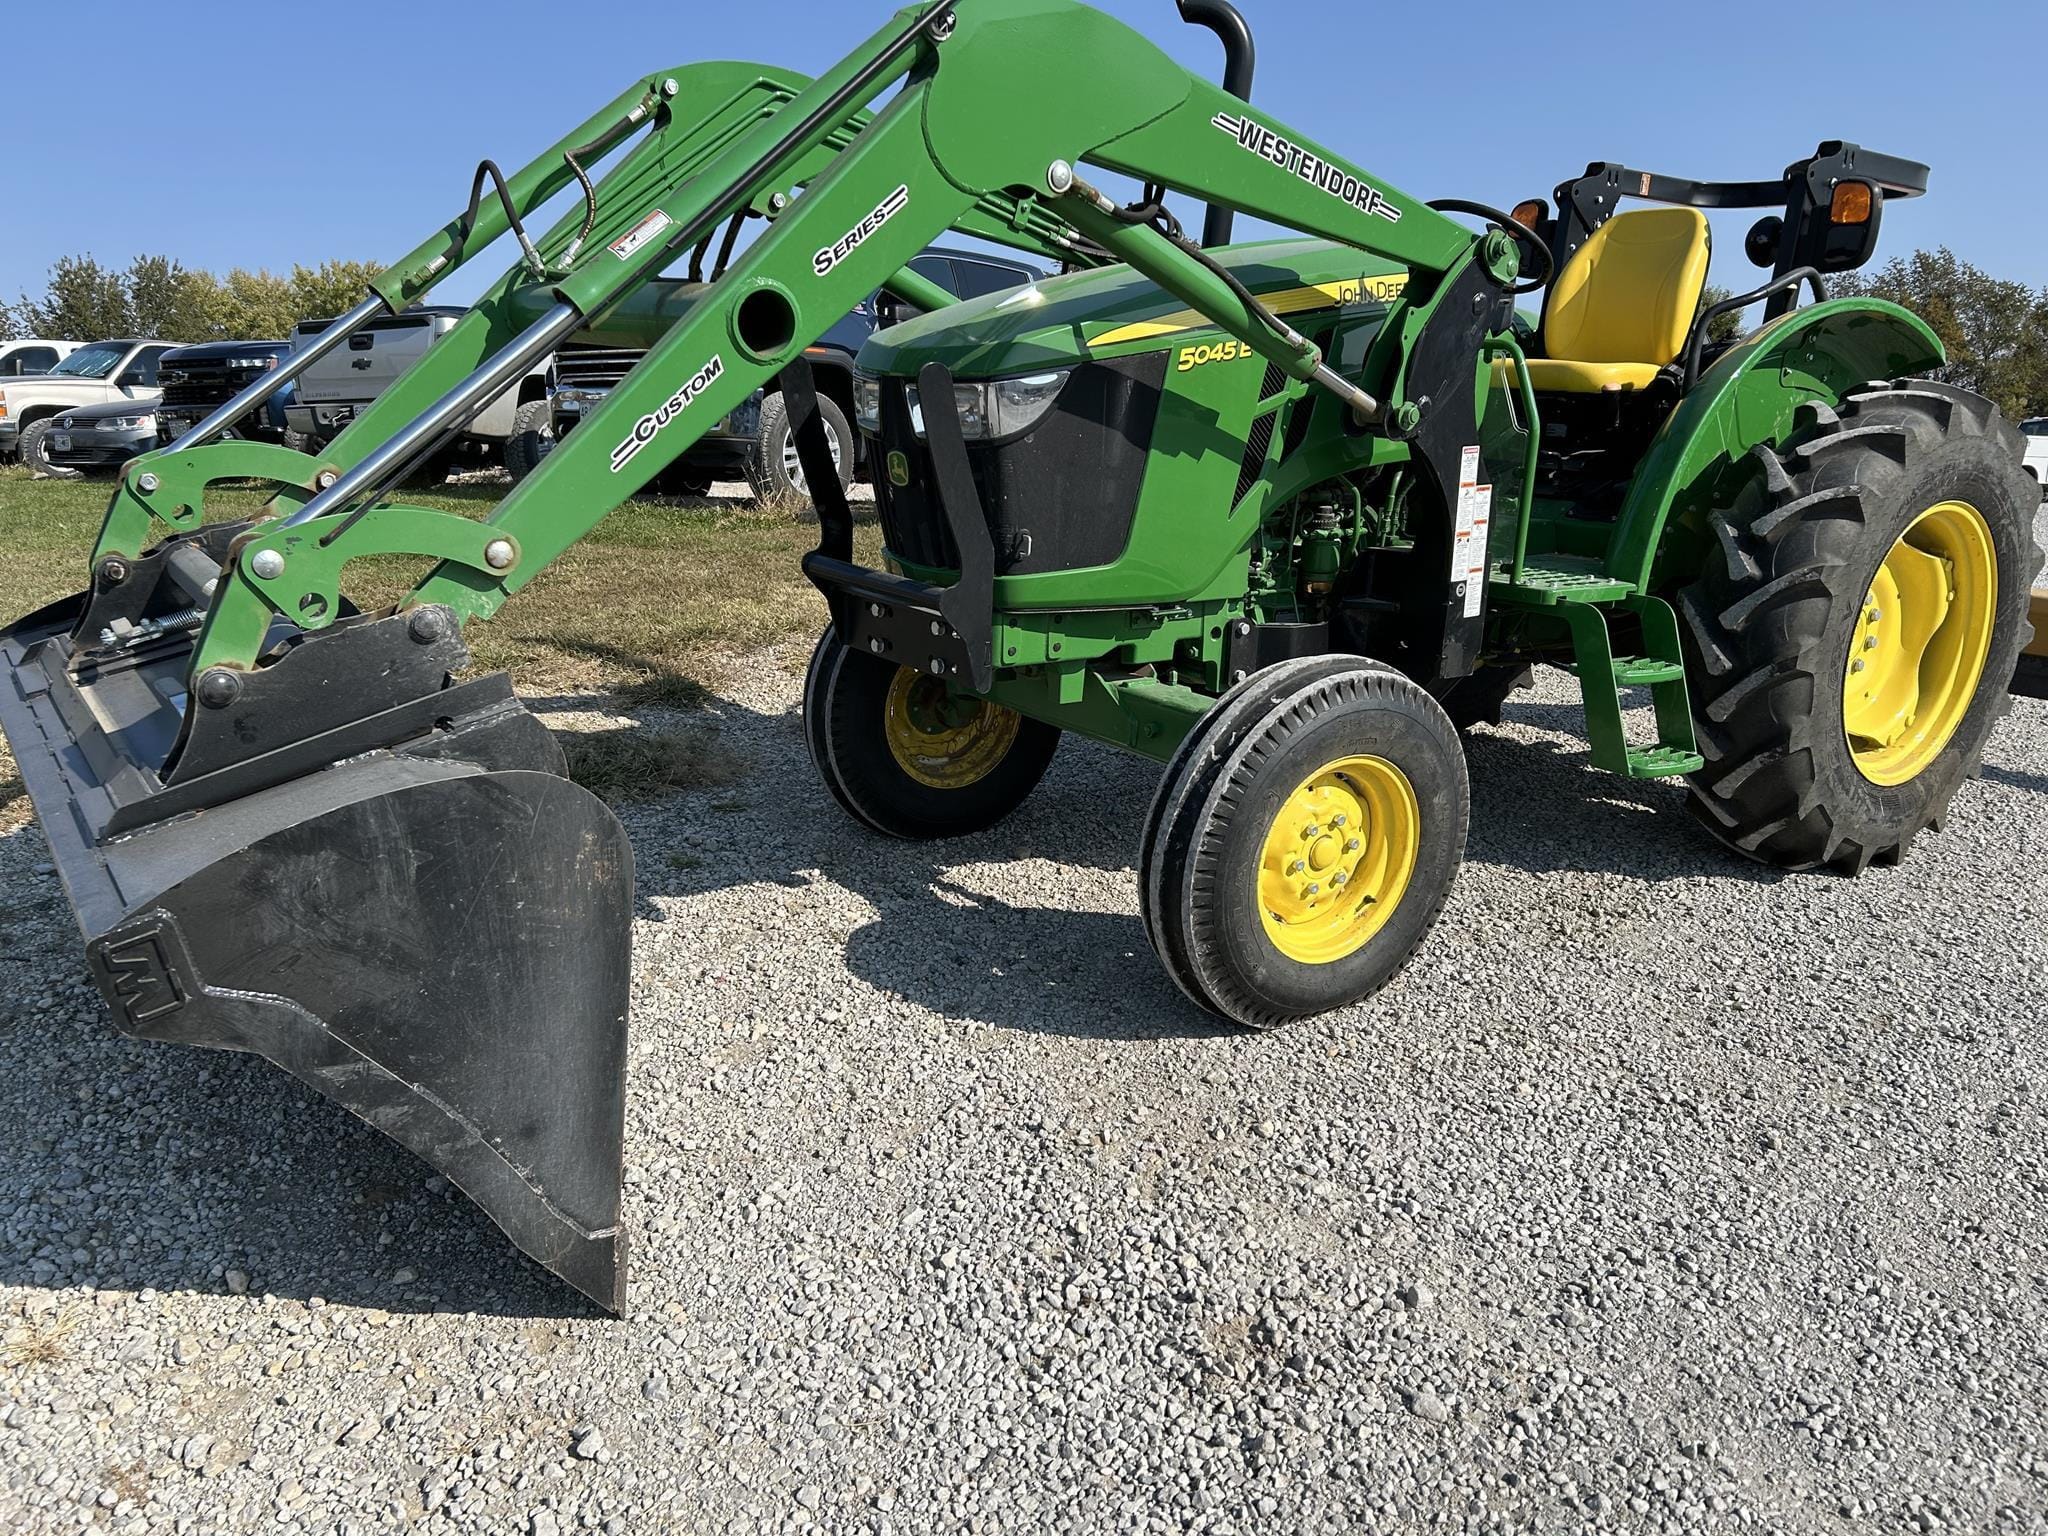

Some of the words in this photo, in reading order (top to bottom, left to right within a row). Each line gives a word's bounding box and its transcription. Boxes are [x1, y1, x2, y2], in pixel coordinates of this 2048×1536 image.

[1237, 118, 1382, 214] WESTENDORF
[814, 207, 887, 274] SERIES
[1333, 284, 1375, 305] JOHN
[634, 358, 722, 443] CUSTOM
